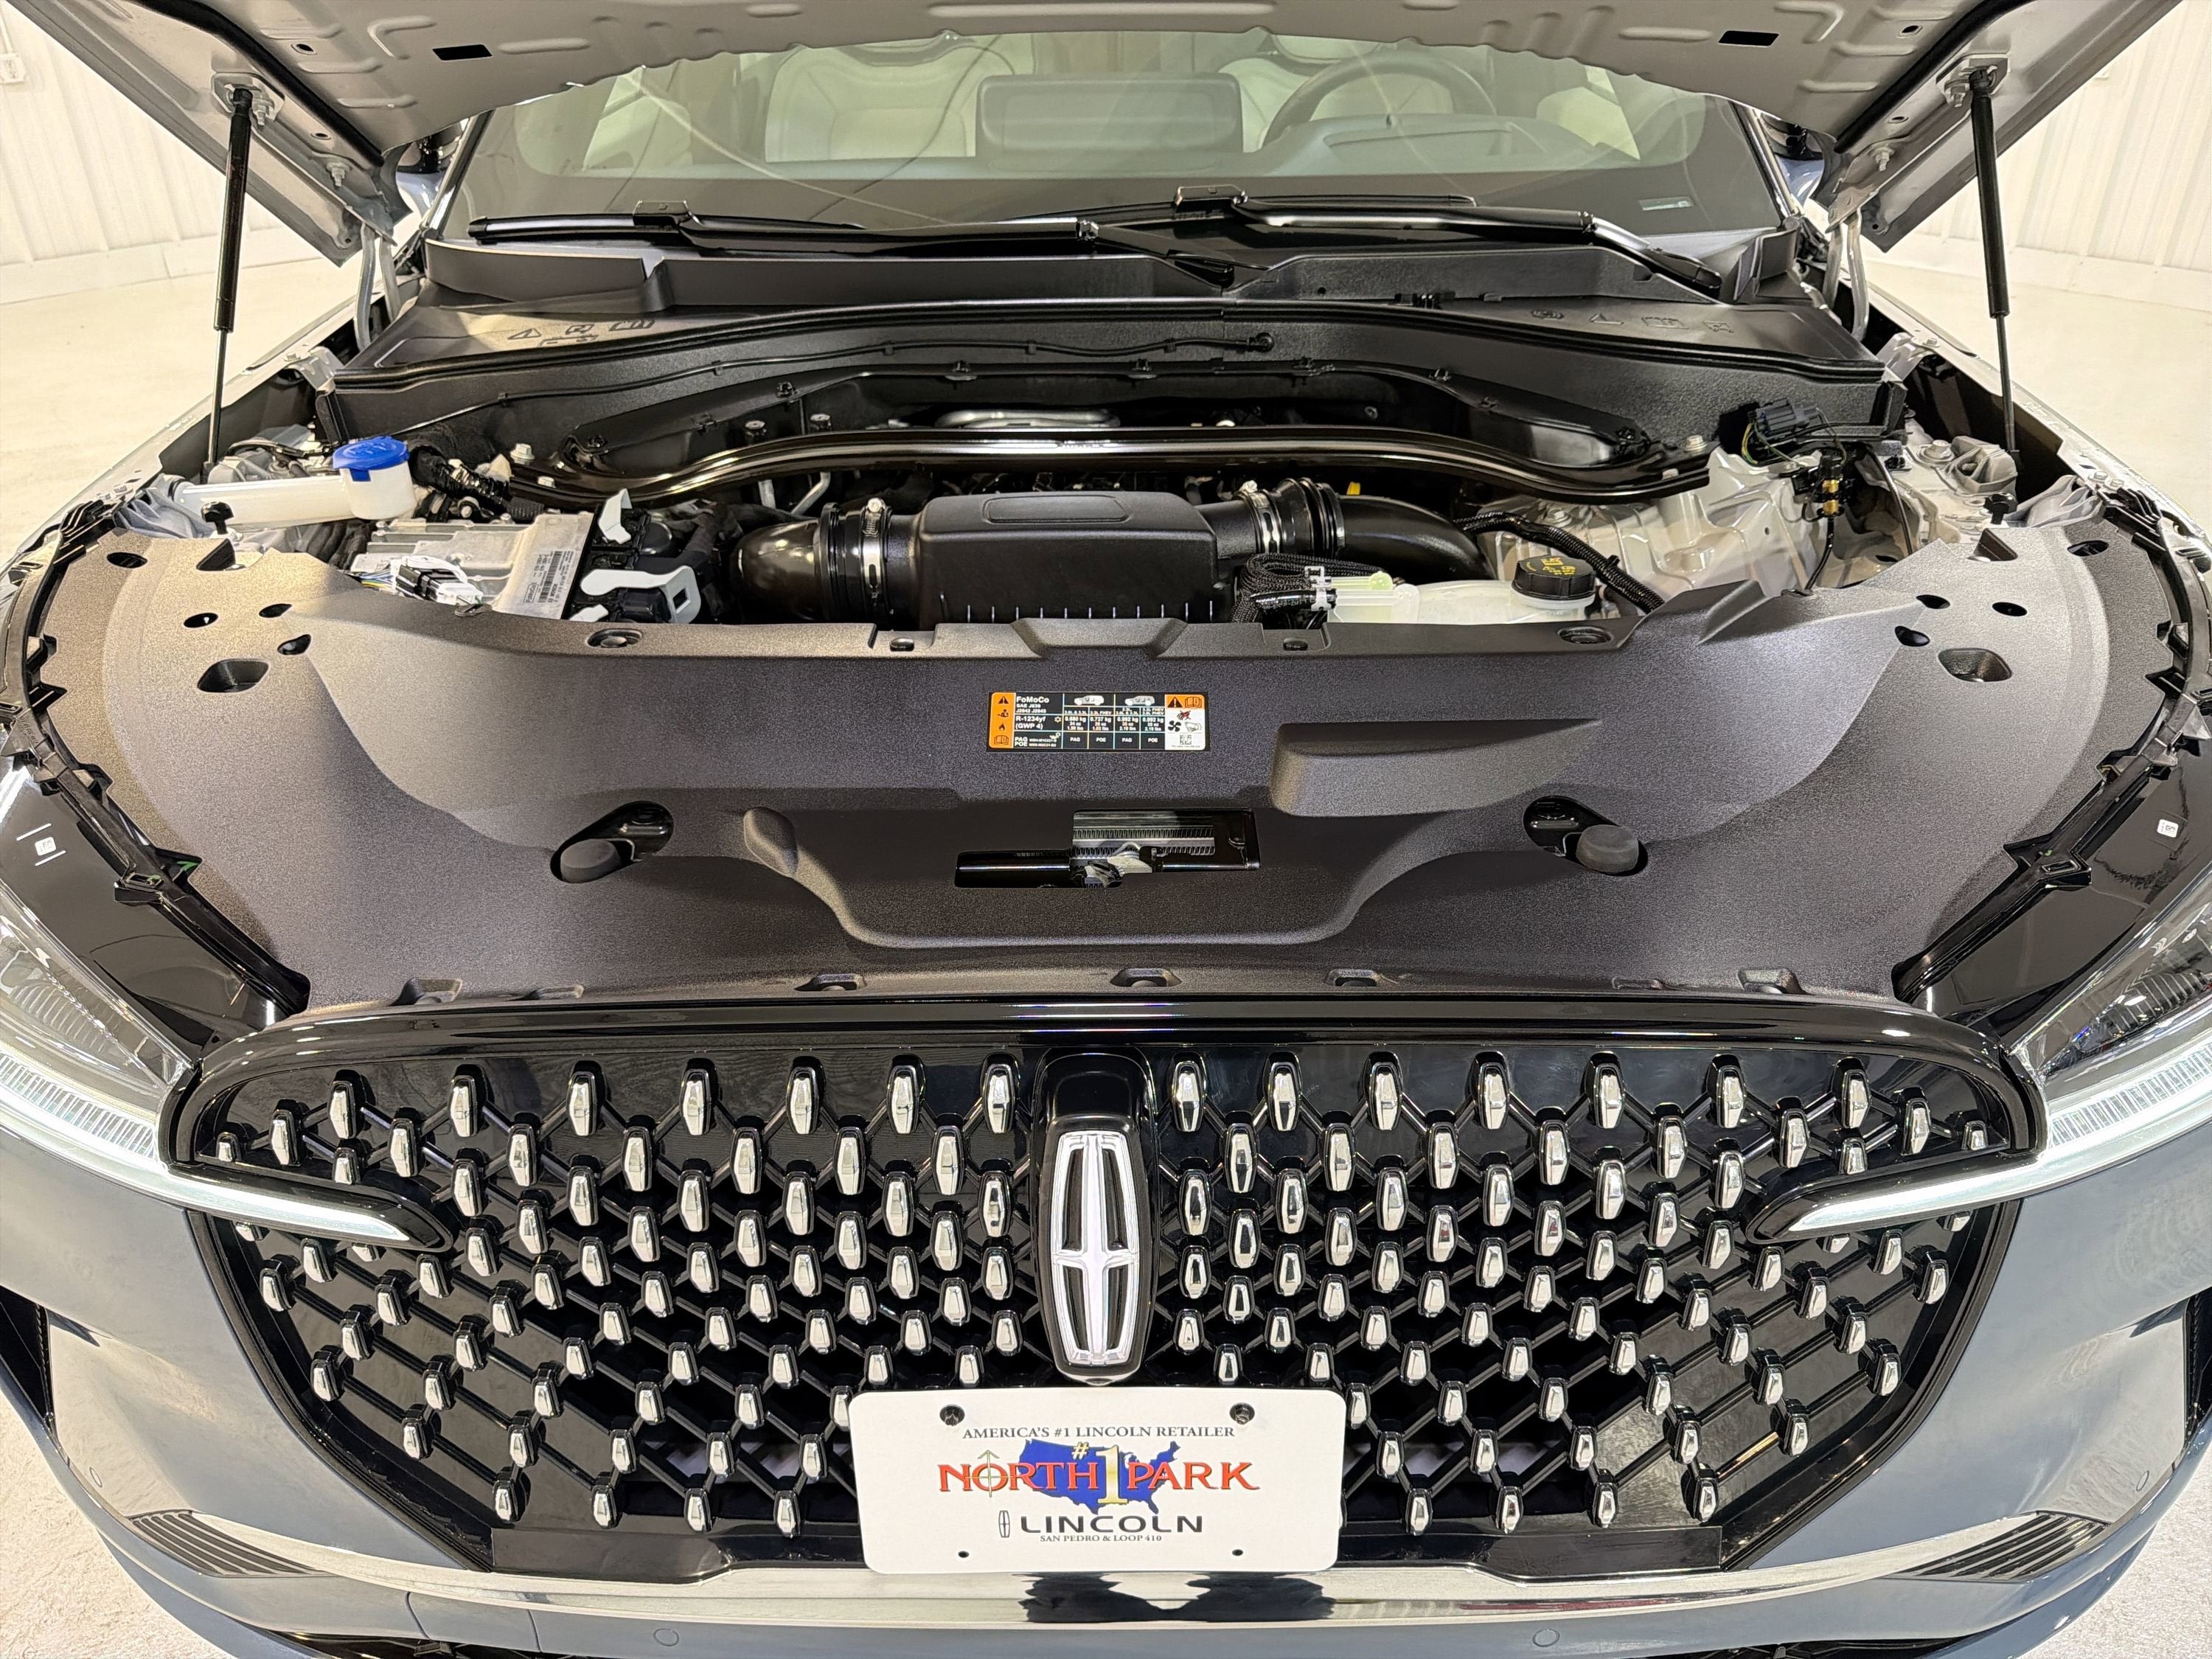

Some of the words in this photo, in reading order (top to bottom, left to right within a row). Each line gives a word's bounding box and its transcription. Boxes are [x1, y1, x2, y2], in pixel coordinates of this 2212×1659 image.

[962, 1427, 1050, 1439] AMERICA'S
[1054, 1427, 1071, 1438] #1
[1075, 1426, 1150, 1437] LINCOLN
[1155, 1427, 1236, 1437] RETAILER
[937, 1461, 1099, 1492] NORTH
[1127, 1461, 1260, 1491] PARK
[1020, 1515, 1203, 1534] LINCOLN
